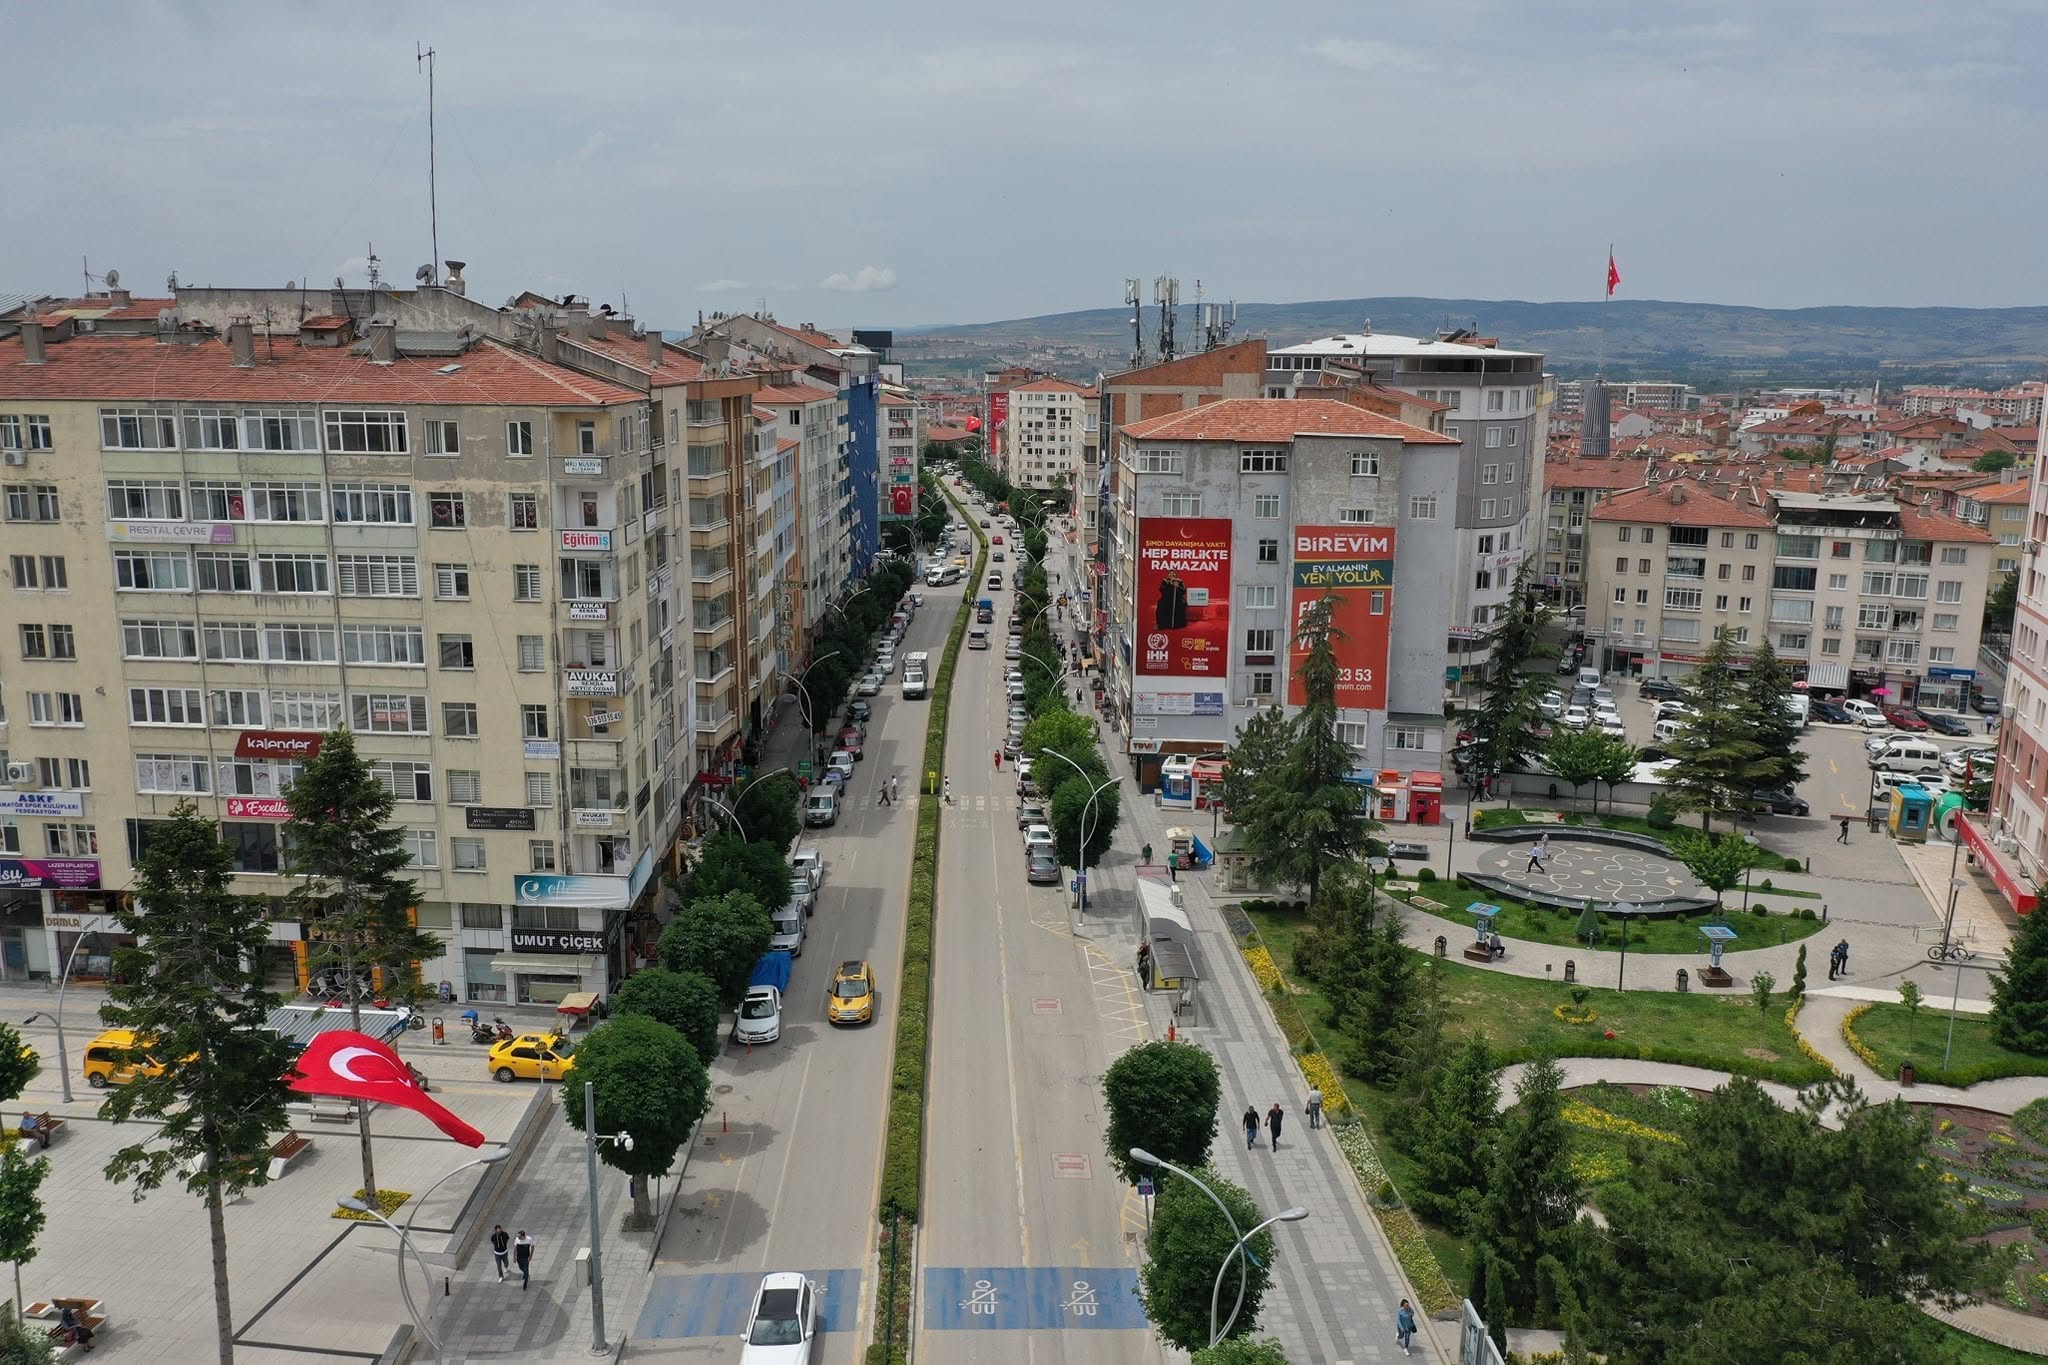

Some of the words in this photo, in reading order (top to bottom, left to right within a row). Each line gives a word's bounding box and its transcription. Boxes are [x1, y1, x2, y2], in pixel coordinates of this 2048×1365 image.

[1165, 540, 1204, 548] DAYANIŞMA
[1142, 548, 1169, 558] HEP
[1151, 560, 1219, 571] RAMAZAN
[1312, 565, 1325, 573] EV
[1327, 564, 1368, 572] ALMANIN
[569, 672, 615, 681] AVUKAT
[1354, 668, 1372, 682] 53
[247, 737, 310, 750] kalender
[18, 794, 55, 803] ASKF
[514, 934, 556, 947] UMUT
[559, 934, 604, 949] ÇİÇEK
